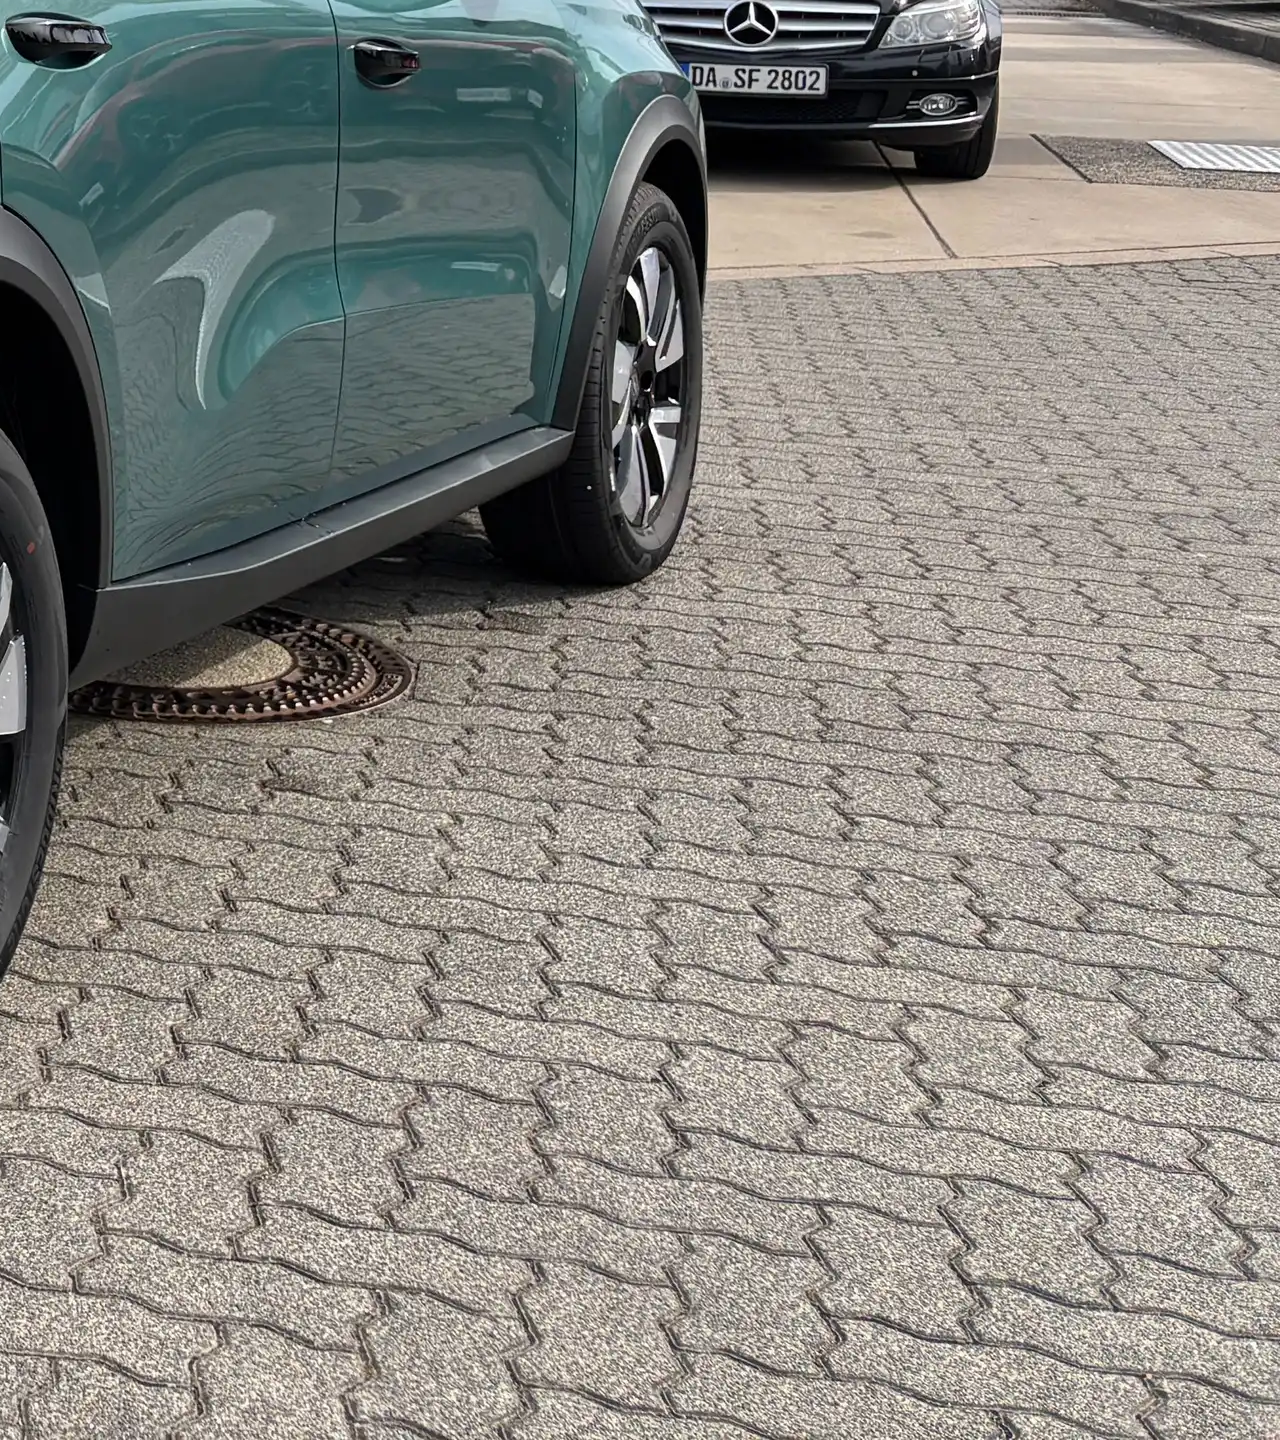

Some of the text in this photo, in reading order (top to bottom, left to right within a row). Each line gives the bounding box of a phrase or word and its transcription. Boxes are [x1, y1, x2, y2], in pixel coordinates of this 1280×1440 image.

[691, 65, 821, 92] DA SF 2802
